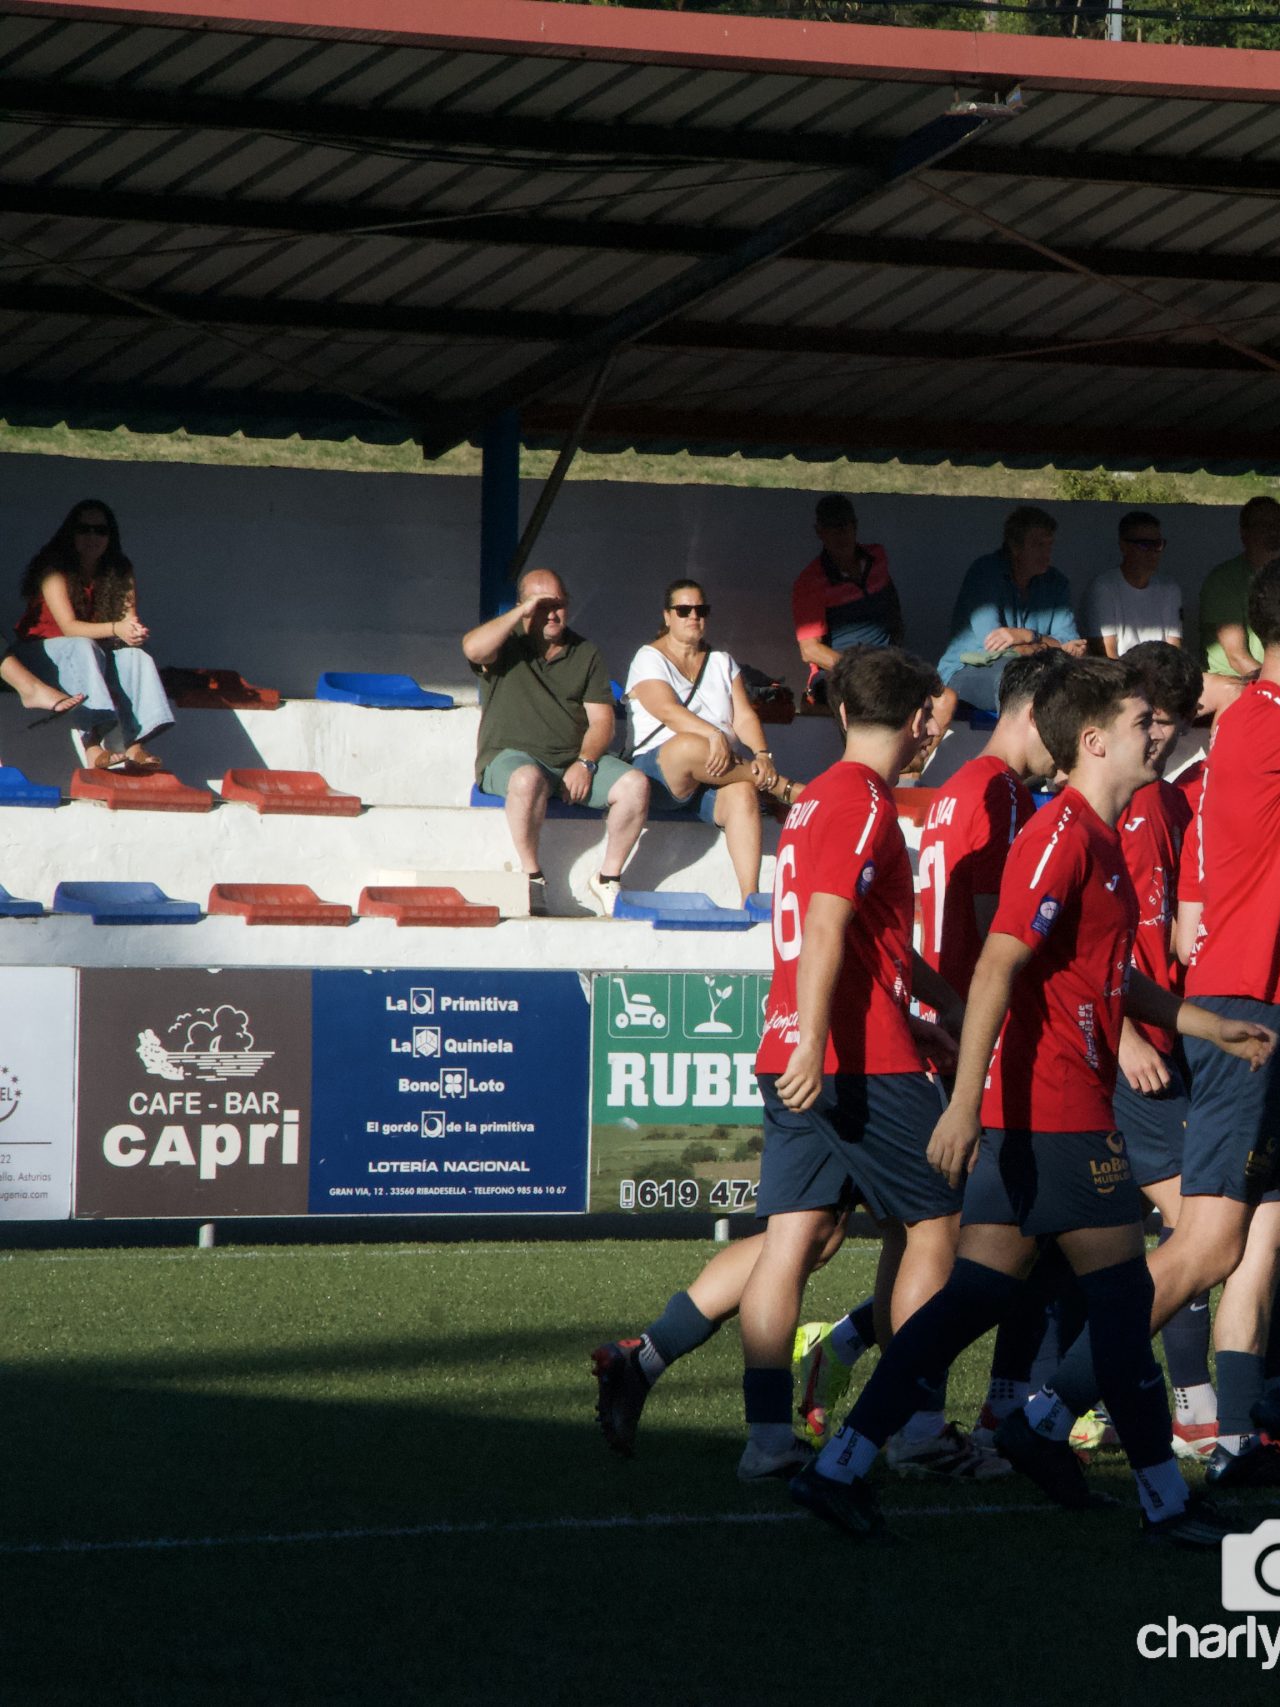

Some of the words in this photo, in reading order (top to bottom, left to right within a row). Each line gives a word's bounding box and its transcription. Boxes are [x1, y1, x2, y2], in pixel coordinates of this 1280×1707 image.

[774, 844, 802, 962] 6
[386, 996, 408, 1012] La
[440, 996, 519, 1012] Primitiva
[390, 1038, 412, 1053] La
[444, 1038, 514, 1055] Quiniela
[398, 1078, 440, 1093] Bono
[468, 1078, 505, 1093] Loto
[607, 1052, 765, 1107] RUBE
[129, 1091, 202, 1115] CAFE
[225, 1091, 280, 1115] BAR
[366, 1122, 379, 1133] El
[382, 1122, 419, 1136] gordo
[446, 1122, 462, 1133] de
[465, 1122, 477, 1133] la
[480, 1122, 535, 1136] primitiva
[368, 1159, 439, 1173] LOTERÍA
[443, 1161, 531, 1173] NACIONAL
[18, 1171, 52, 1181] Asturias
[0, 1190, 49, 1202] ugenia.com
[329, 1187, 353, 1196] GRAN
[374, 1187, 384, 1196] 12
[390, 1186, 415, 1196] 33560
[416, 1186, 467, 1196] RIBADESELLA
[474, 1186, 515, 1196] TELEFONO
[516, 1186, 532, 1195] 985
[533, 1186, 543, 1195] 86
[545, 1185, 555, 1195] 10
[556, 1185, 567, 1195] 67
[637, 1179, 699, 1208] 619
